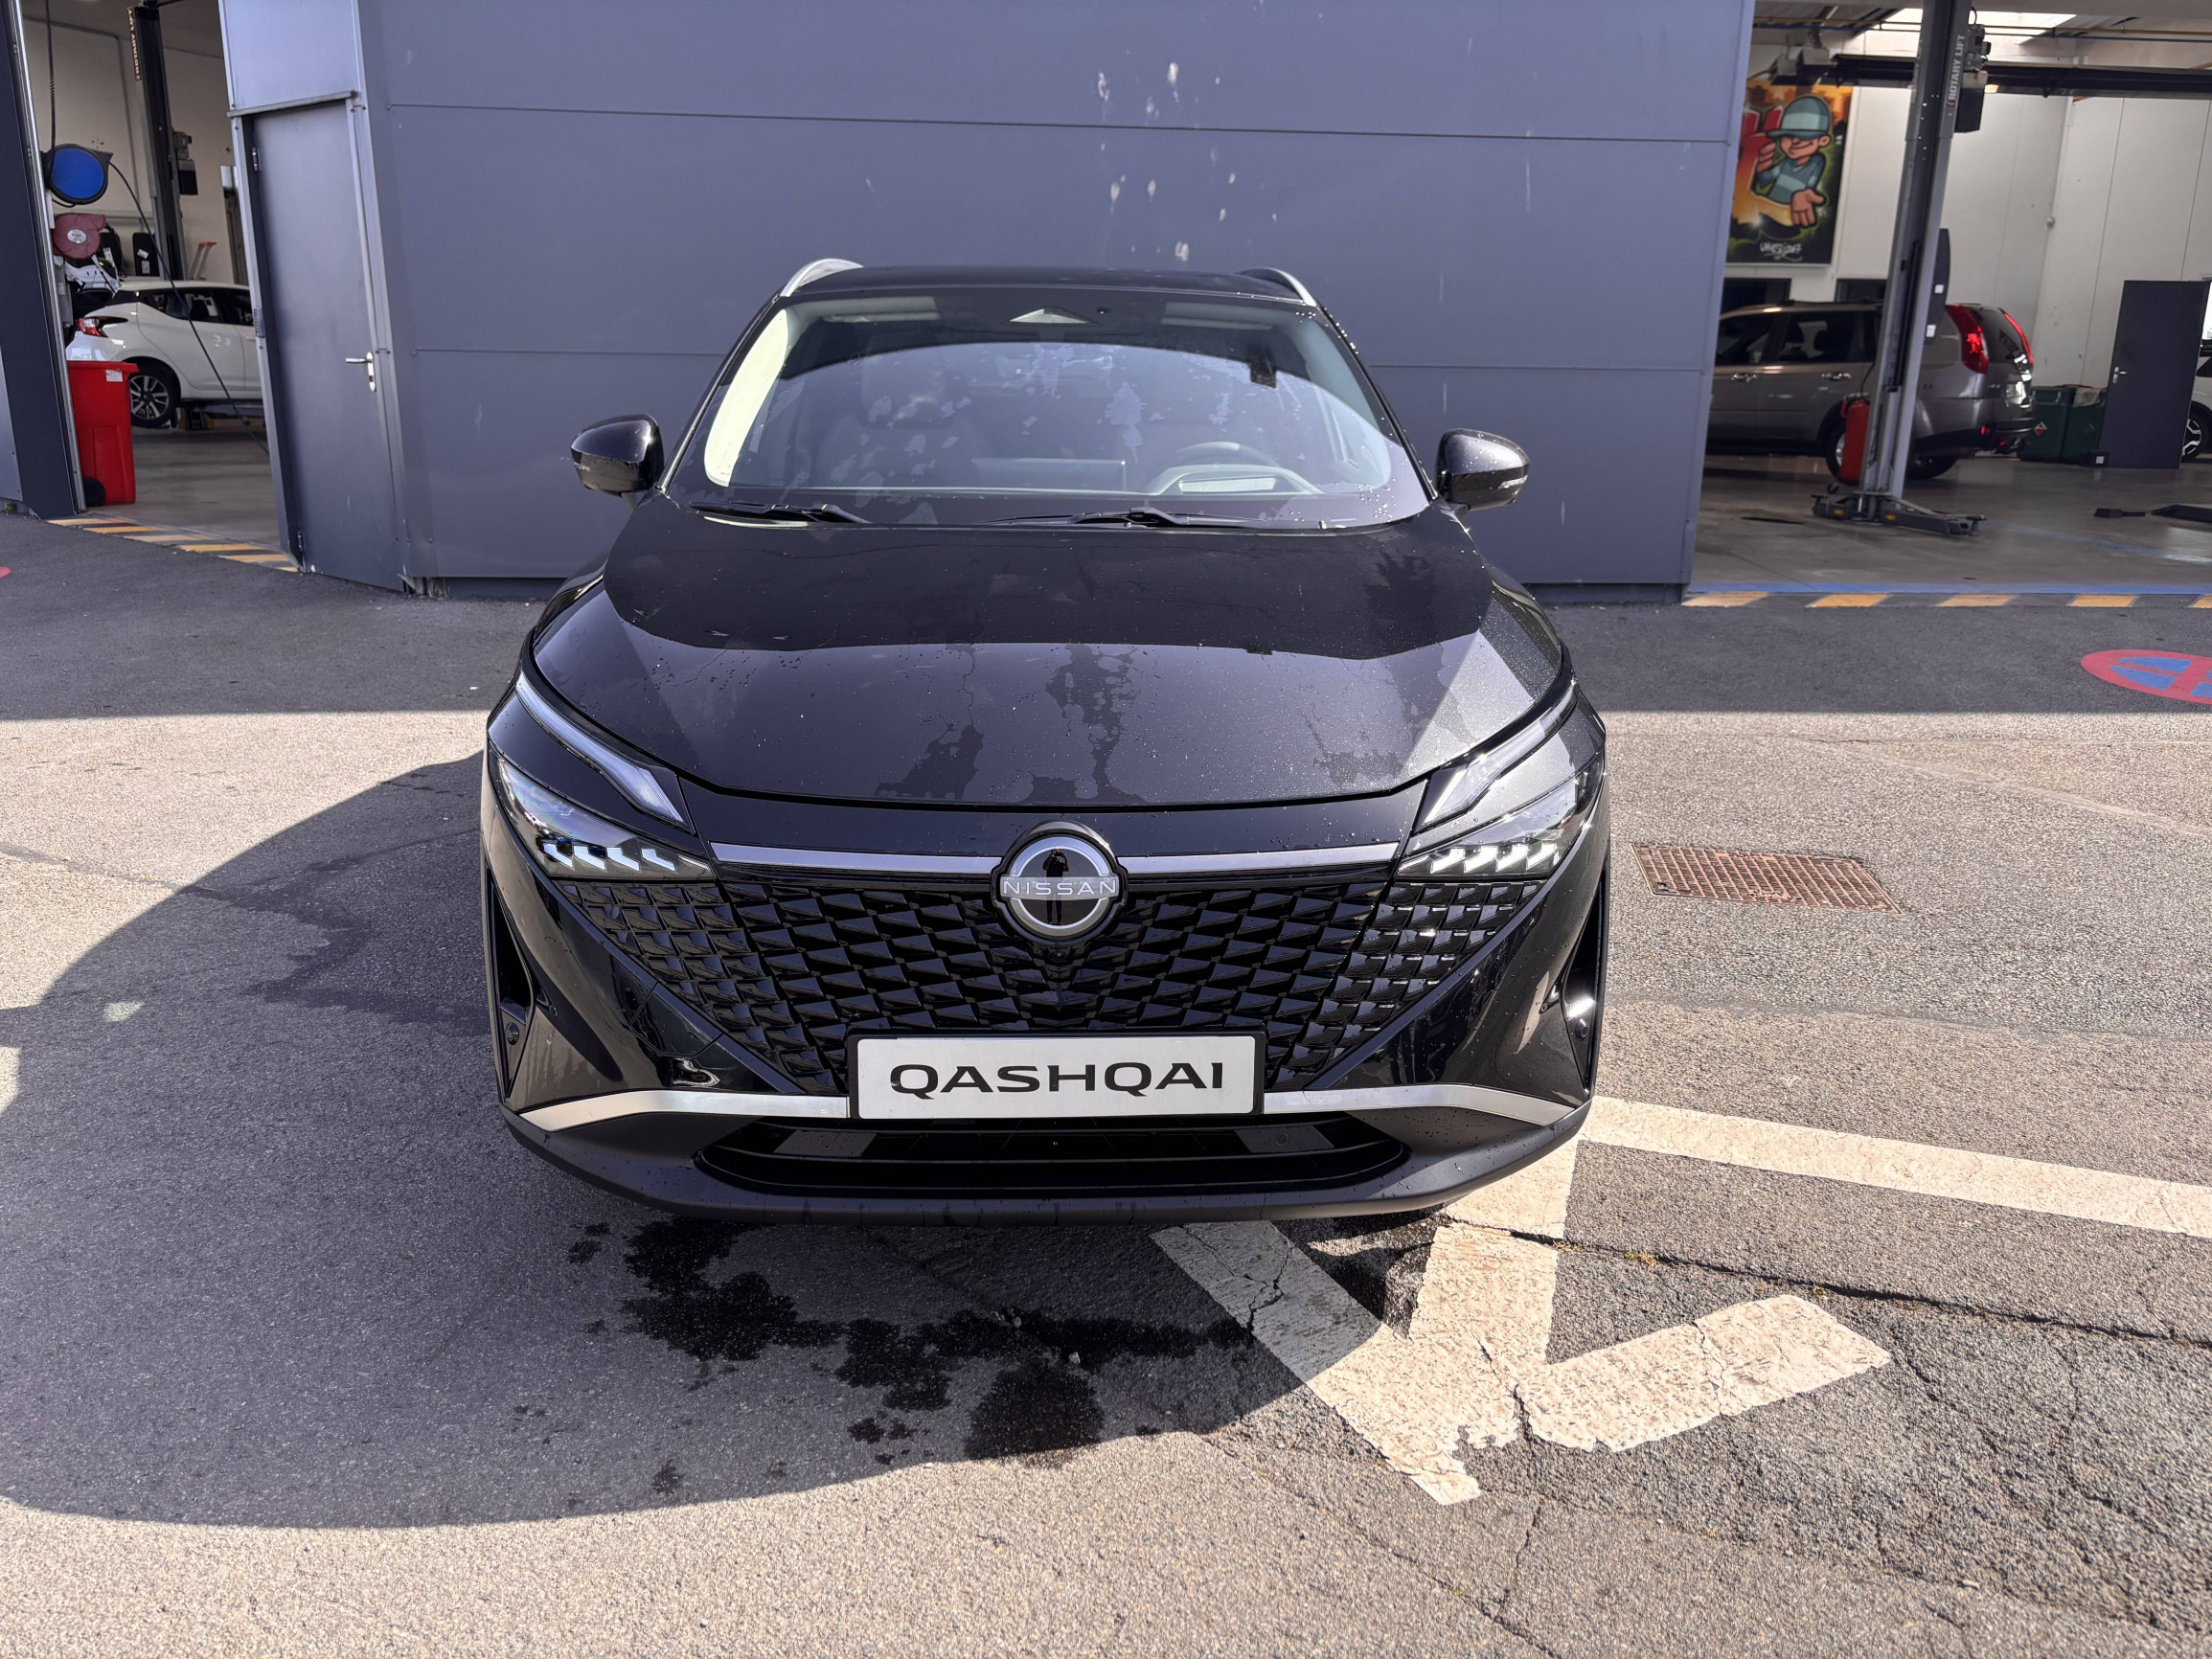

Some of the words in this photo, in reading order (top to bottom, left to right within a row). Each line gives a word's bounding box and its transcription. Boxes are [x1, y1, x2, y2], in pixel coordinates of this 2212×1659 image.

[1954, 34, 1965, 57] LIFT
[1948, 58, 1961, 101] ROTARY
[1003, 879, 1116, 896] NISSAN
[890, 1061, 1223, 1100] QASHQAI
